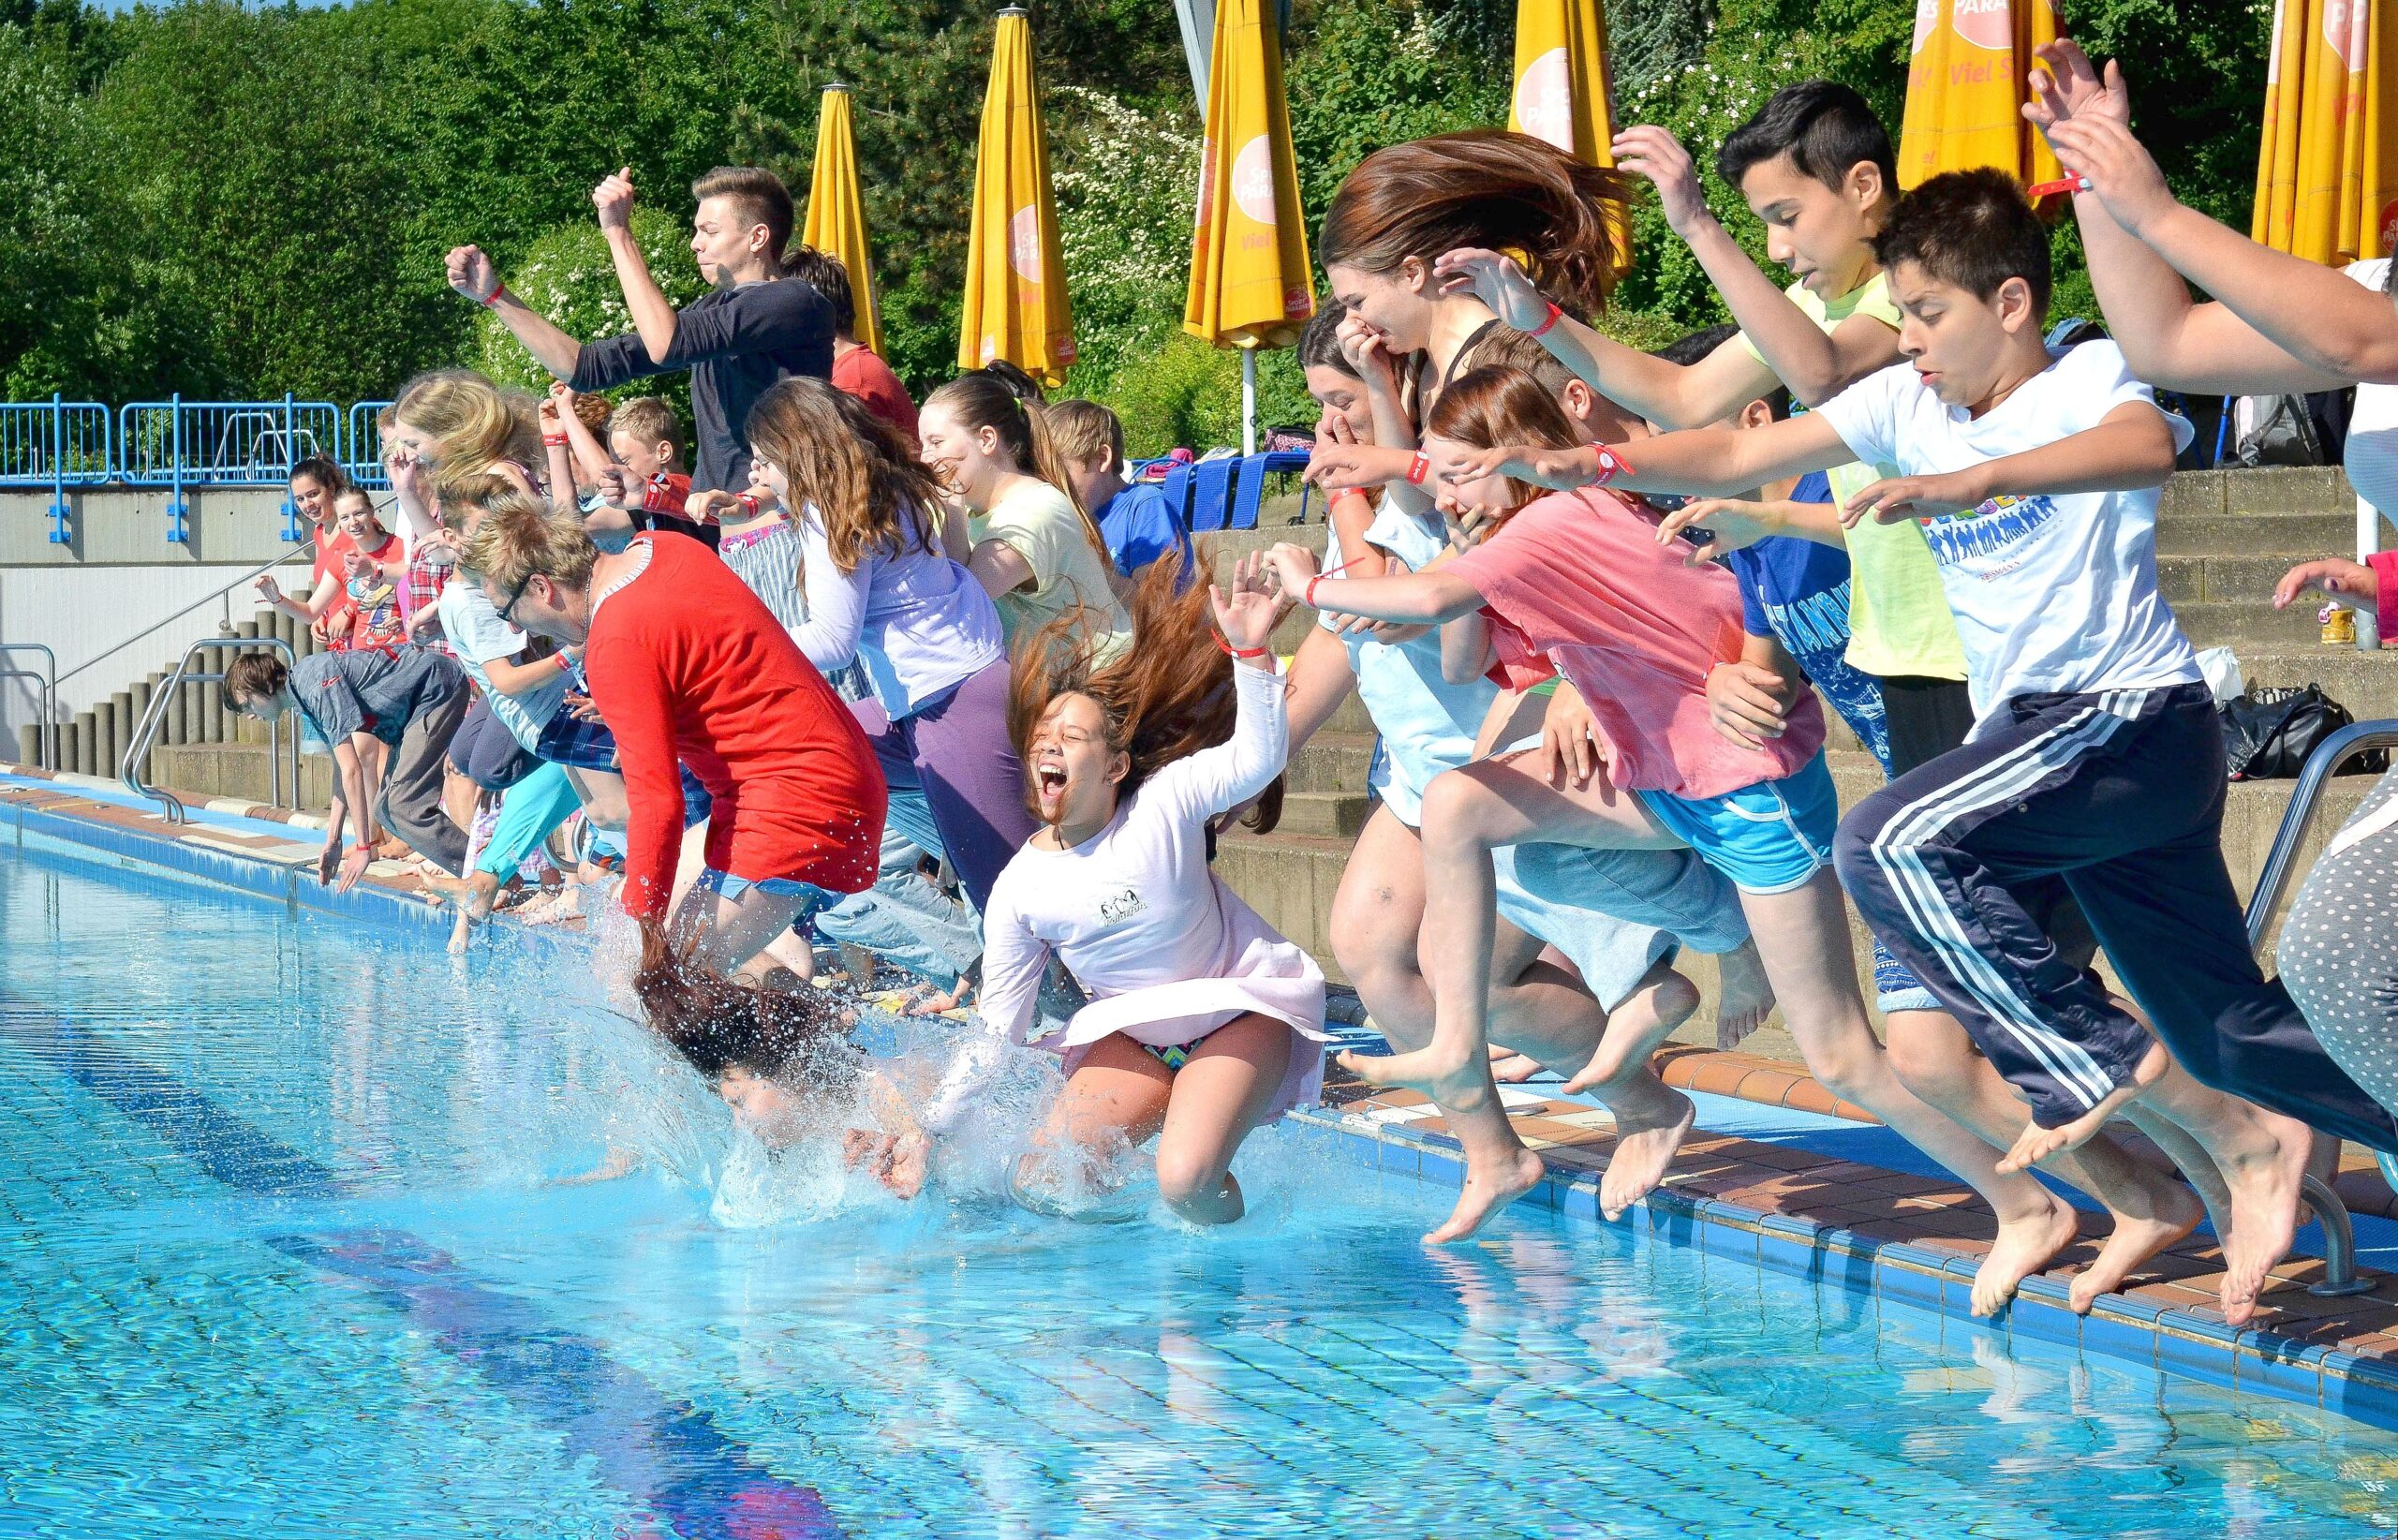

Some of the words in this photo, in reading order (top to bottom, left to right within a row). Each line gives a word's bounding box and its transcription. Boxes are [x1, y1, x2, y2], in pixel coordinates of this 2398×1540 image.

[1953, 0, 2008, 15] PARA
[1951, 60, 1992, 85] Viel
[1241, 232, 1271, 250] Viel
